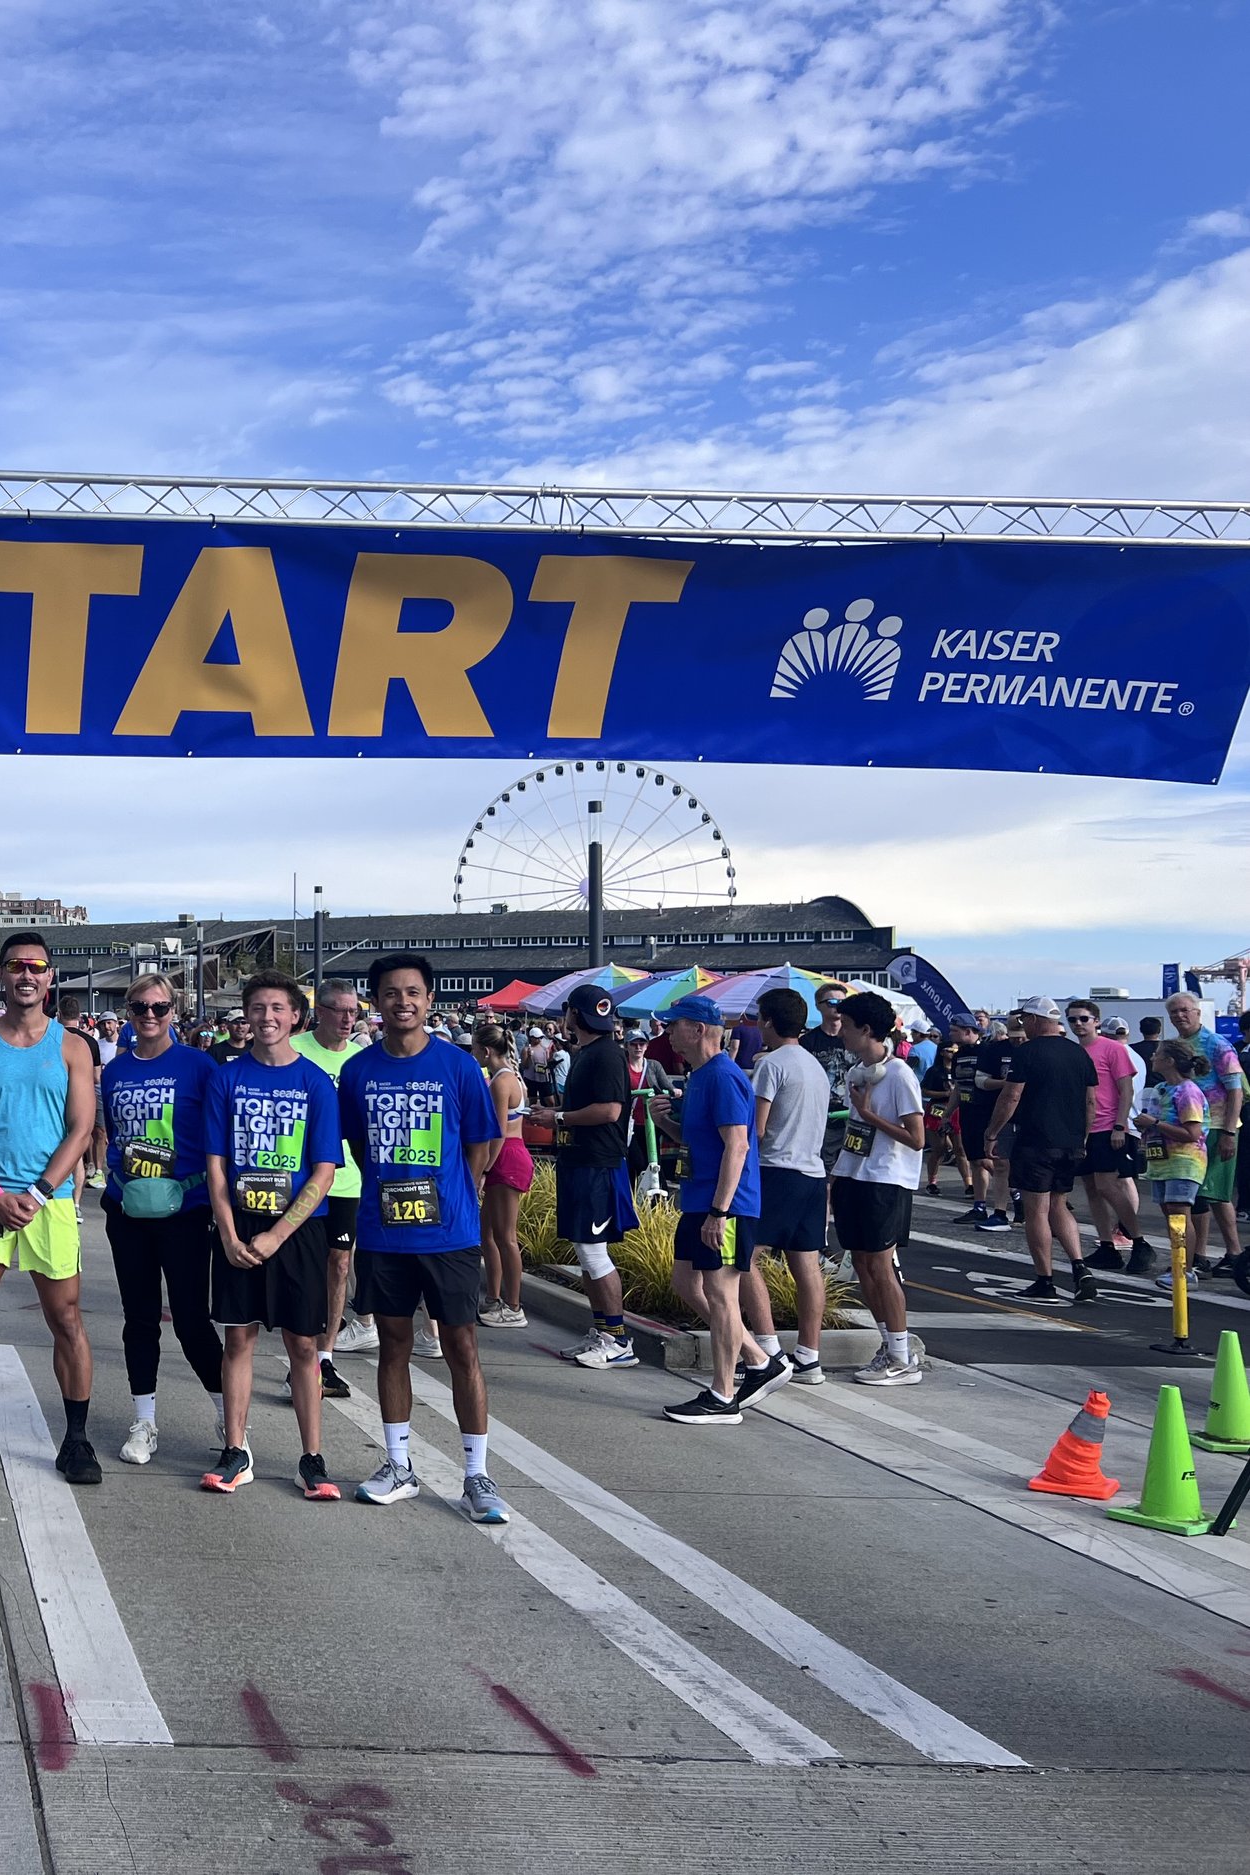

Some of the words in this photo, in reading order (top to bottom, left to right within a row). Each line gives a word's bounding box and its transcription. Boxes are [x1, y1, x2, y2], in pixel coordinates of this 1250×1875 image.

[930, 629, 1060, 662] KAISER
[920, 980, 943, 1011] Tours
[144, 1077, 176, 1087] seafair
[406, 1080, 443, 1092] seafair
[112, 1087, 175, 1107] TORCH
[272, 1089, 307, 1100] seafair
[365, 1093, 443, 1112] TORCH
[111, 1103, 162, 1120] LIGHT
[234, 1098, 308, 1120] TORCH
[233, 1115, 293, 1135] LIGHT
[366, 1111, 430, 1129] LIGHT
[234, 1132, 276, 1151] RUN
[367, 1128, 410, 1146] RUN
[234, 1149, 257, 1167] 5K
[261, 1153, 297, 1168] 2025
[370, 1146, 394, 1163] 5K
[398, 1148, 437, 1163] 2025
[130, 1157, 162, 1179] 700
[246, 1190, 278, 1210] 821
[392, 1199, 427, 1220] 126
